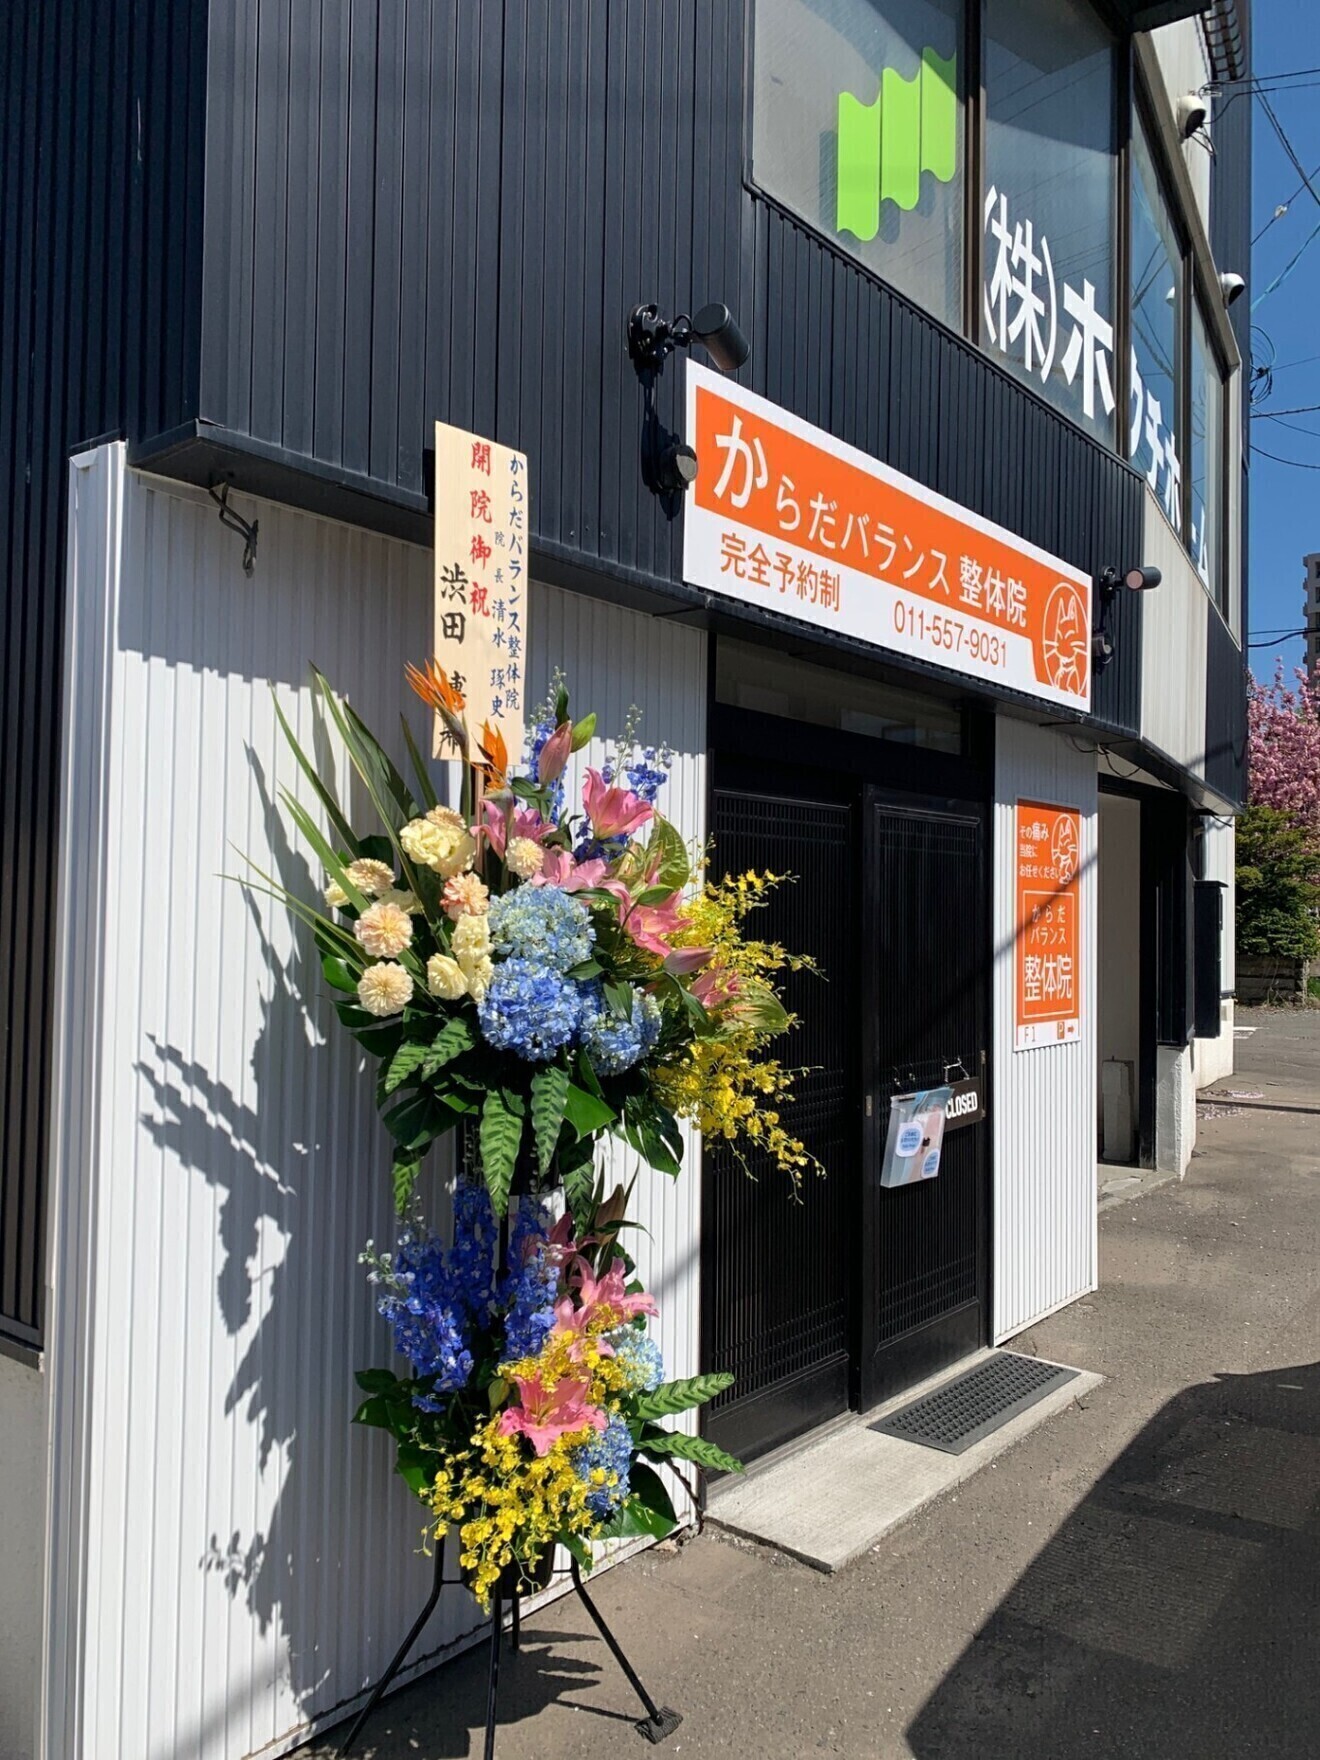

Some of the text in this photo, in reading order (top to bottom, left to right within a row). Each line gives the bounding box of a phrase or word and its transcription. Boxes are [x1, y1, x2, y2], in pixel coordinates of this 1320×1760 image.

[469, 441, 492, 617] 開院御祝
[440, 562, 469, 645] 渋田
[505, 454, 524, 710] からだバランス整体院
[720, 532, 840, 612] 完全予約制
[491, 598, 507, 648] 清水
[894, 600, 1008, 668] 011-557-9031
[1030, 926, 1067, 946] バランス
[1024, 953, 1072, 1002] 整体院
[945, 1091, 978, 1120] CLOSED
